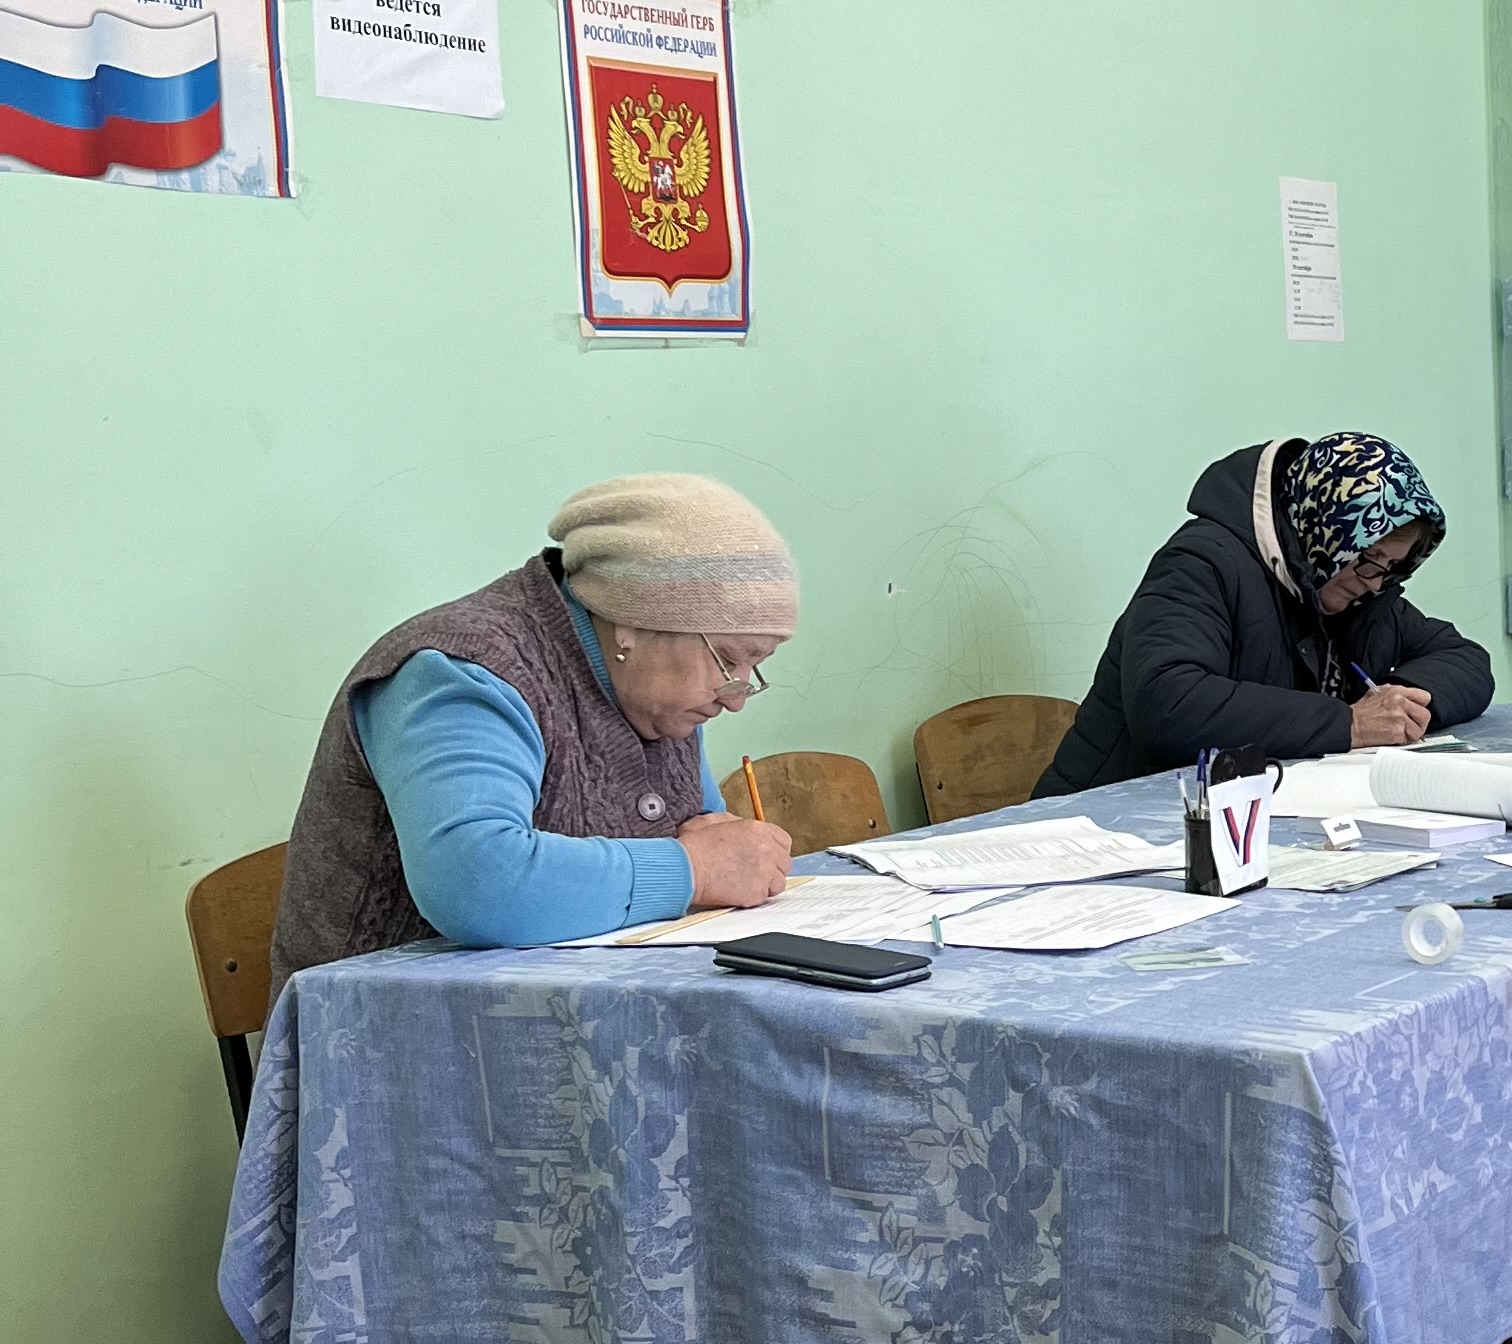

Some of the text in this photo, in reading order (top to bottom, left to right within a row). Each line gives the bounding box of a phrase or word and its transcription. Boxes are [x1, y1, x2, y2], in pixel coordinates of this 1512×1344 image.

[330, 16, 487, 54] видеонаблюдение
[690, 14, 715, 32] ГЕРБ
[583, 24, 718, 59] РОССИЙСКОЙ ФЕДЕРАЦИИ
[1218, 797, 1262, 868] V
